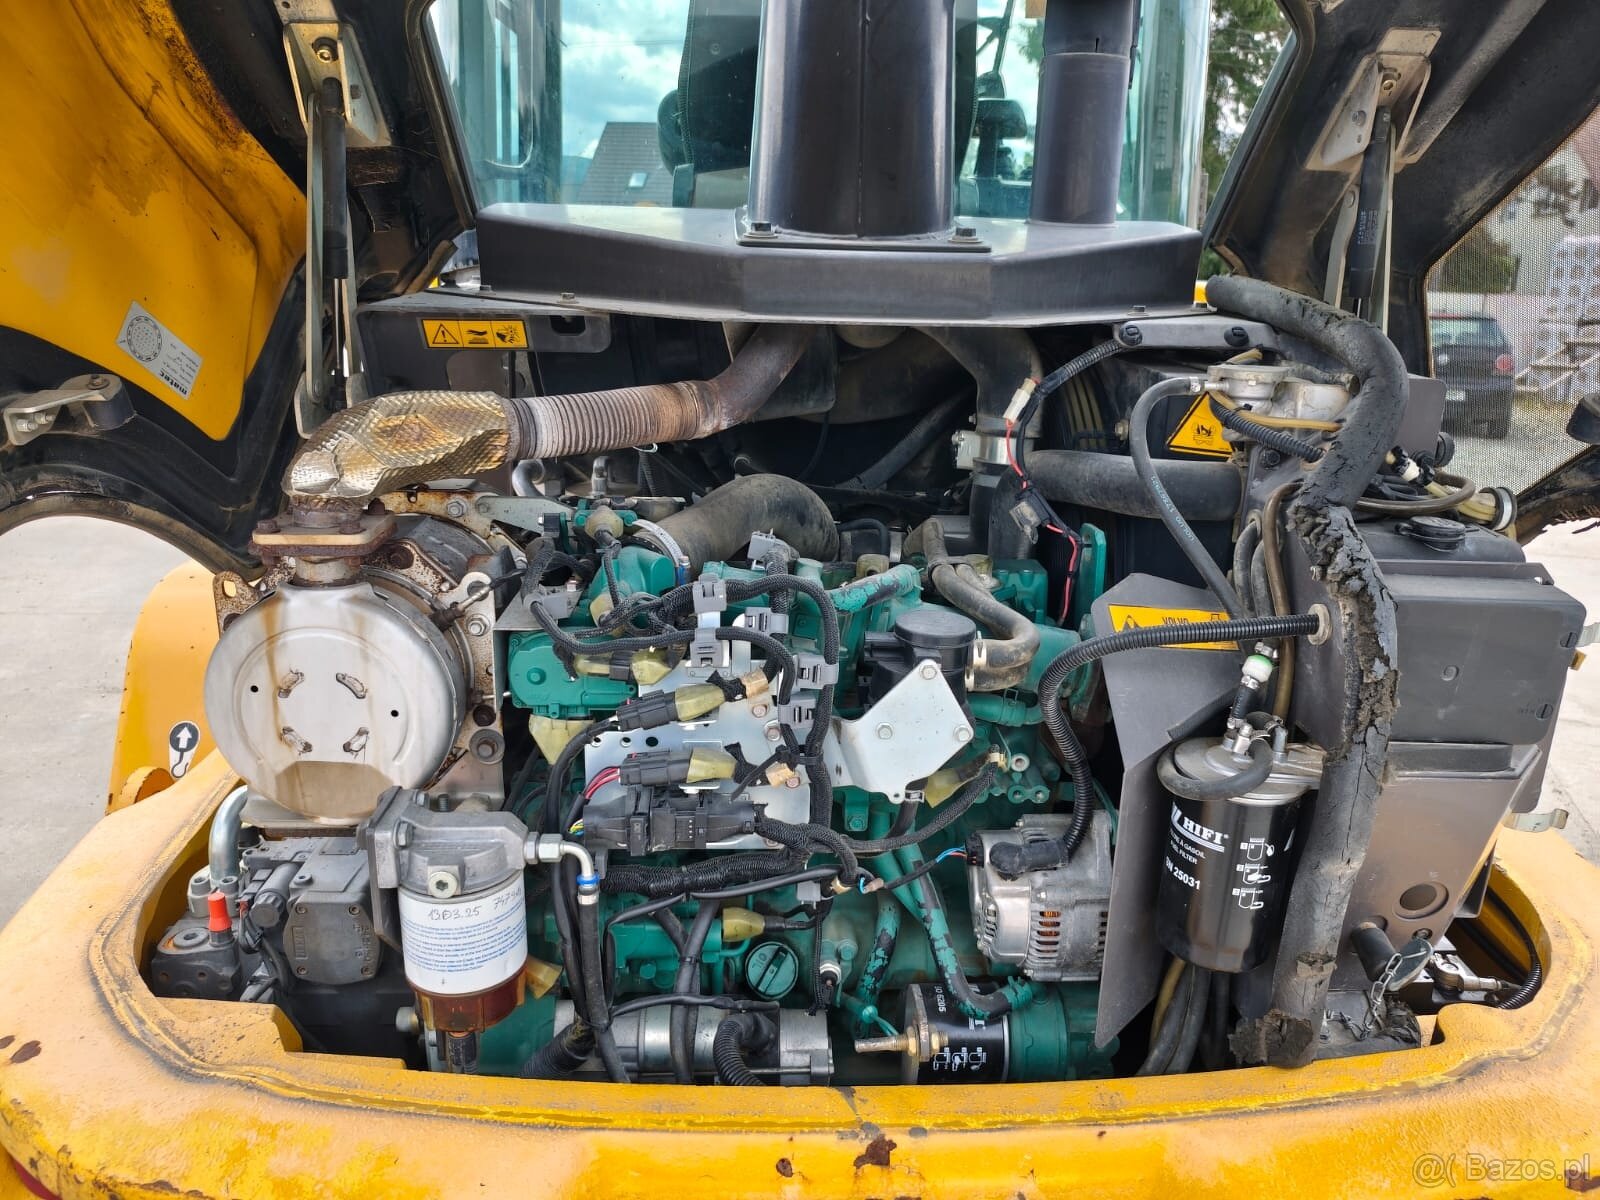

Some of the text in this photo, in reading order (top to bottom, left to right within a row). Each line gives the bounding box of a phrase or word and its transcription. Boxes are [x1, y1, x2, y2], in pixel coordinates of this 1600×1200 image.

[159, 369, 188, 396] matec
[1182, 816, 1224, 845] HIFI
[1179, 848, 1198, 865] FILTER
[1173, 866, 1201, 890] 25031
